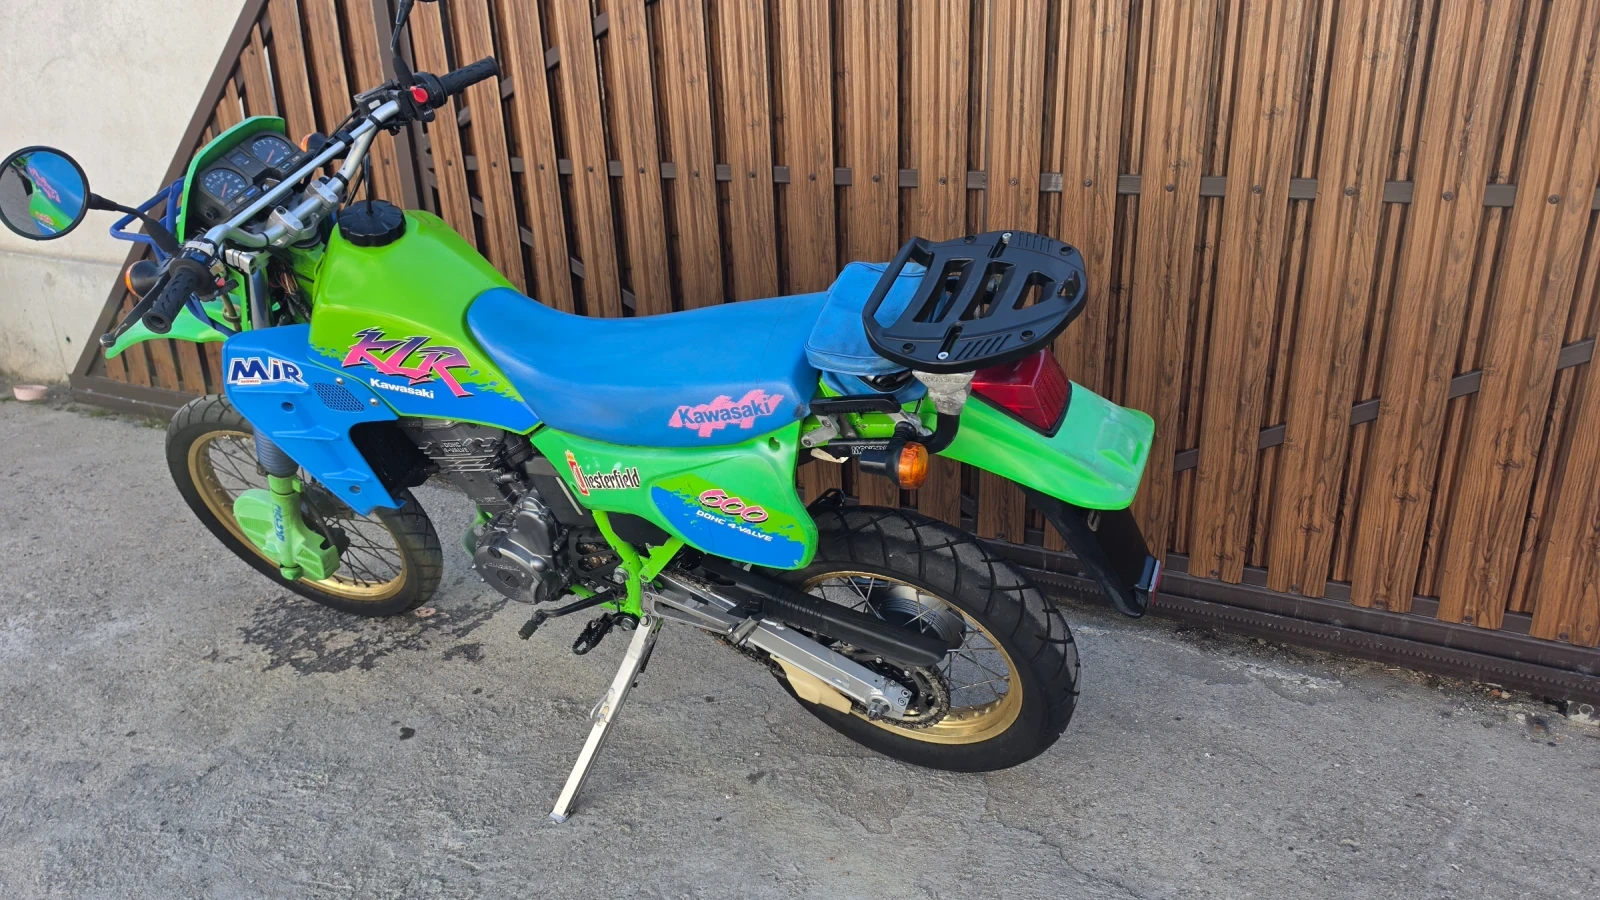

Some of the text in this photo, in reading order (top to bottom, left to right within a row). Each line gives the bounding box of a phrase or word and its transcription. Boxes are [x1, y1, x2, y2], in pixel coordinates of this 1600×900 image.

[341, 326, 474, 398] KLR
[370, 377, 435, 399] Kawasaki
[677, 397, 772, 425] Kawasaki
[566, 455, 641, 496] Chesterfield
[699, 488, 769, 523] 600
[696, 509, 774, 542] DOHC 4-VALVE
